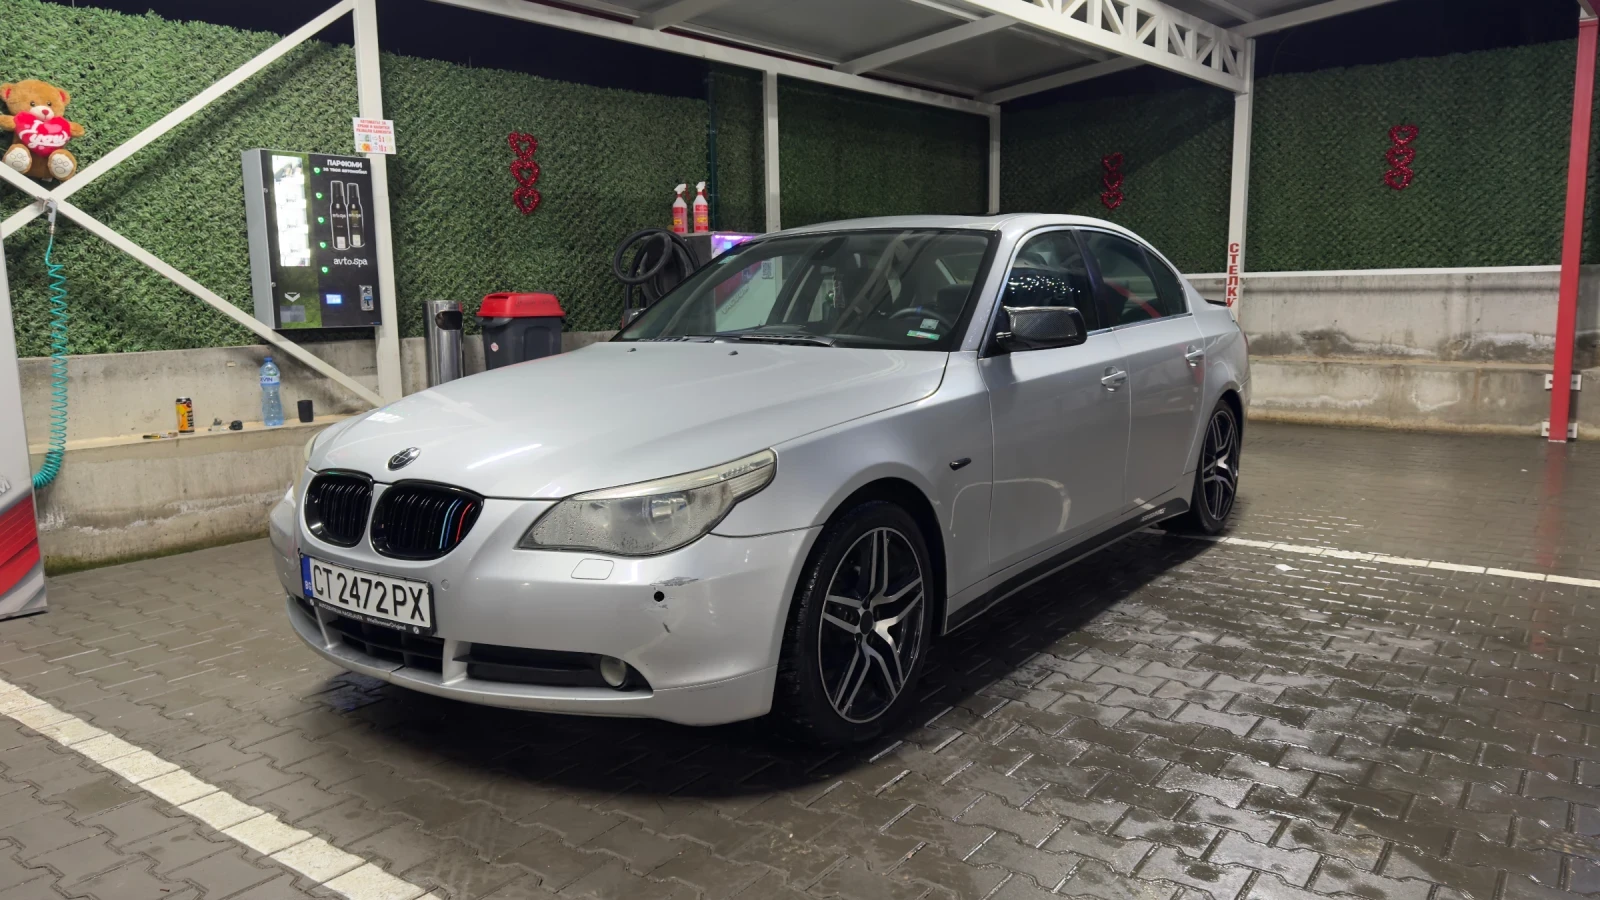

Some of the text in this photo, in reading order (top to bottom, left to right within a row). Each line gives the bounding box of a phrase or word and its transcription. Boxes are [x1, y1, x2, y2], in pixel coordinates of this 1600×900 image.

[327, 159, 362, 168] ПАРФЮМИ
[333, 256, 368, 268] avto.spa
[304, 580, 312, 590] BG
